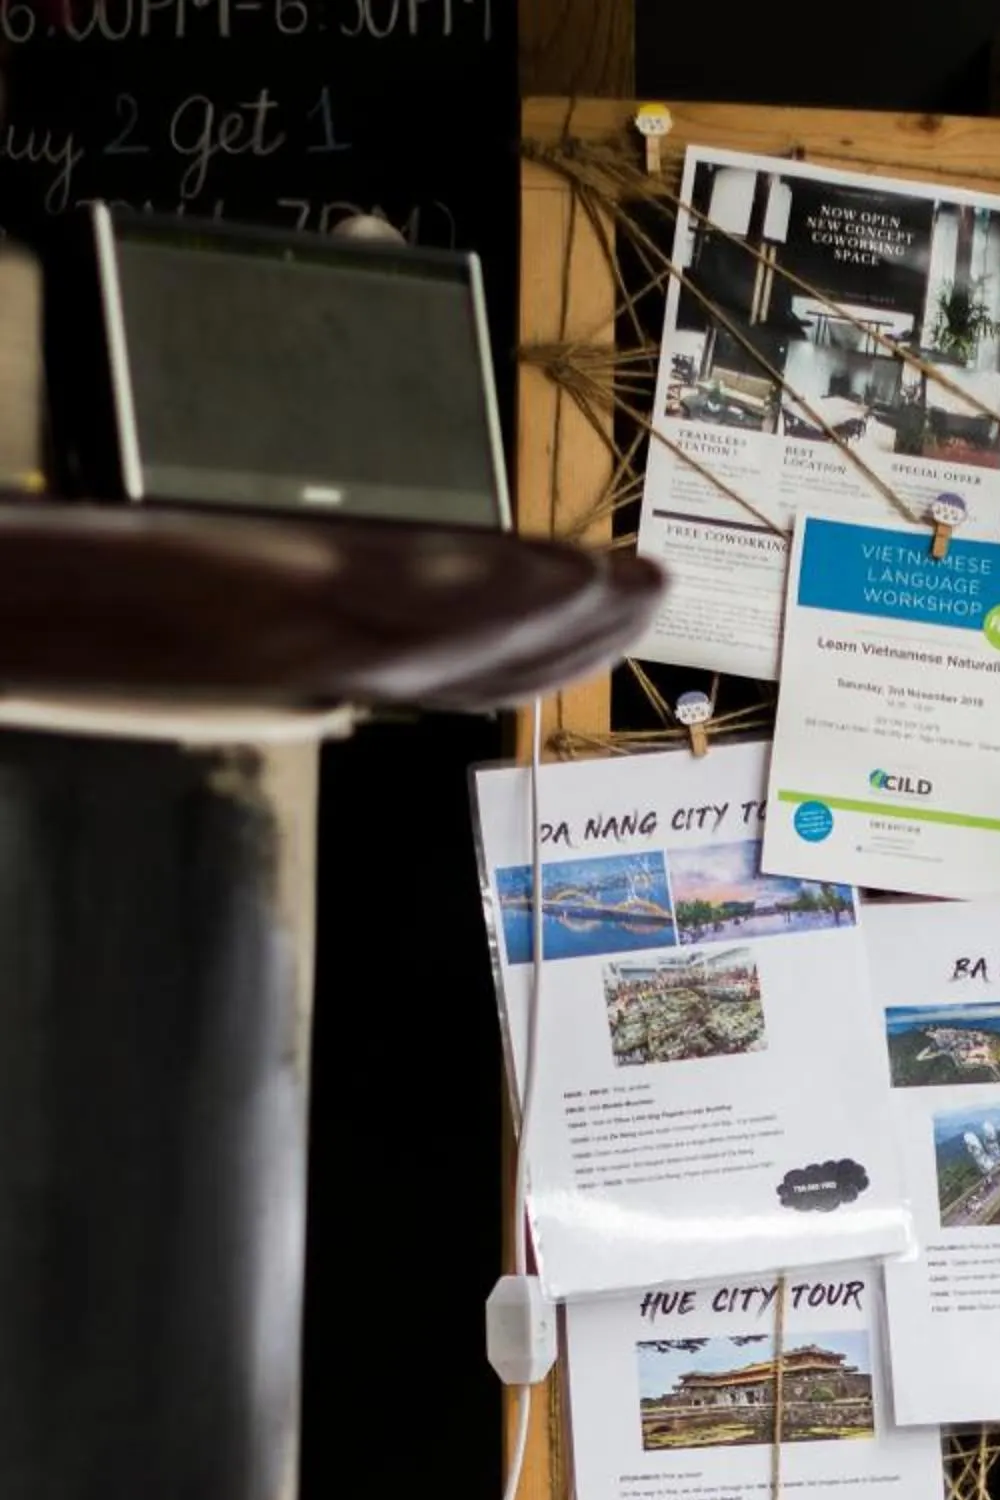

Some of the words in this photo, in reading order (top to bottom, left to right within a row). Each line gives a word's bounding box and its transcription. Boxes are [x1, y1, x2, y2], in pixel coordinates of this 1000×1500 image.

[0, 124, 85, 213] uy
[103, 94, 150, 154] 2
[307, 86, 352, 153] 1
[820, 204, 857, 220] NOW
[860, 211, 901, 229] OPEN
[806, 215, 841, 232] NEW
[844, 223, 914, 245] CONCEPT
[810, 231, 906, 256] COWORKING
[833, 249, 879, 267] SPACE
[785, 446, 814, 459] BEST
[783, 457, 847, 475] LOCATION
[891, 463, 938, 480] SPECIAL
[943, 471, 982, 485] OFFER
[667, 525, 698, 540] FREE
[867, 566, 981, 596] LANGUAGE
[863, 587, 983, 616] WORKSHOP
[817, 636, 857, 654] Learn
[861, 643, 943, 667] Vietnamese
[884, 775, 934, 796] CILD
[584, 811, 657, 841] NANG
[671, 802, 729, 831] CITY
[950, 957, 990, 983] BA
[640, 1290, 697, 1322] HUE
[711, 1285, 779, 1317] CITY
[792, 1280, 865, 1311] TOUR
